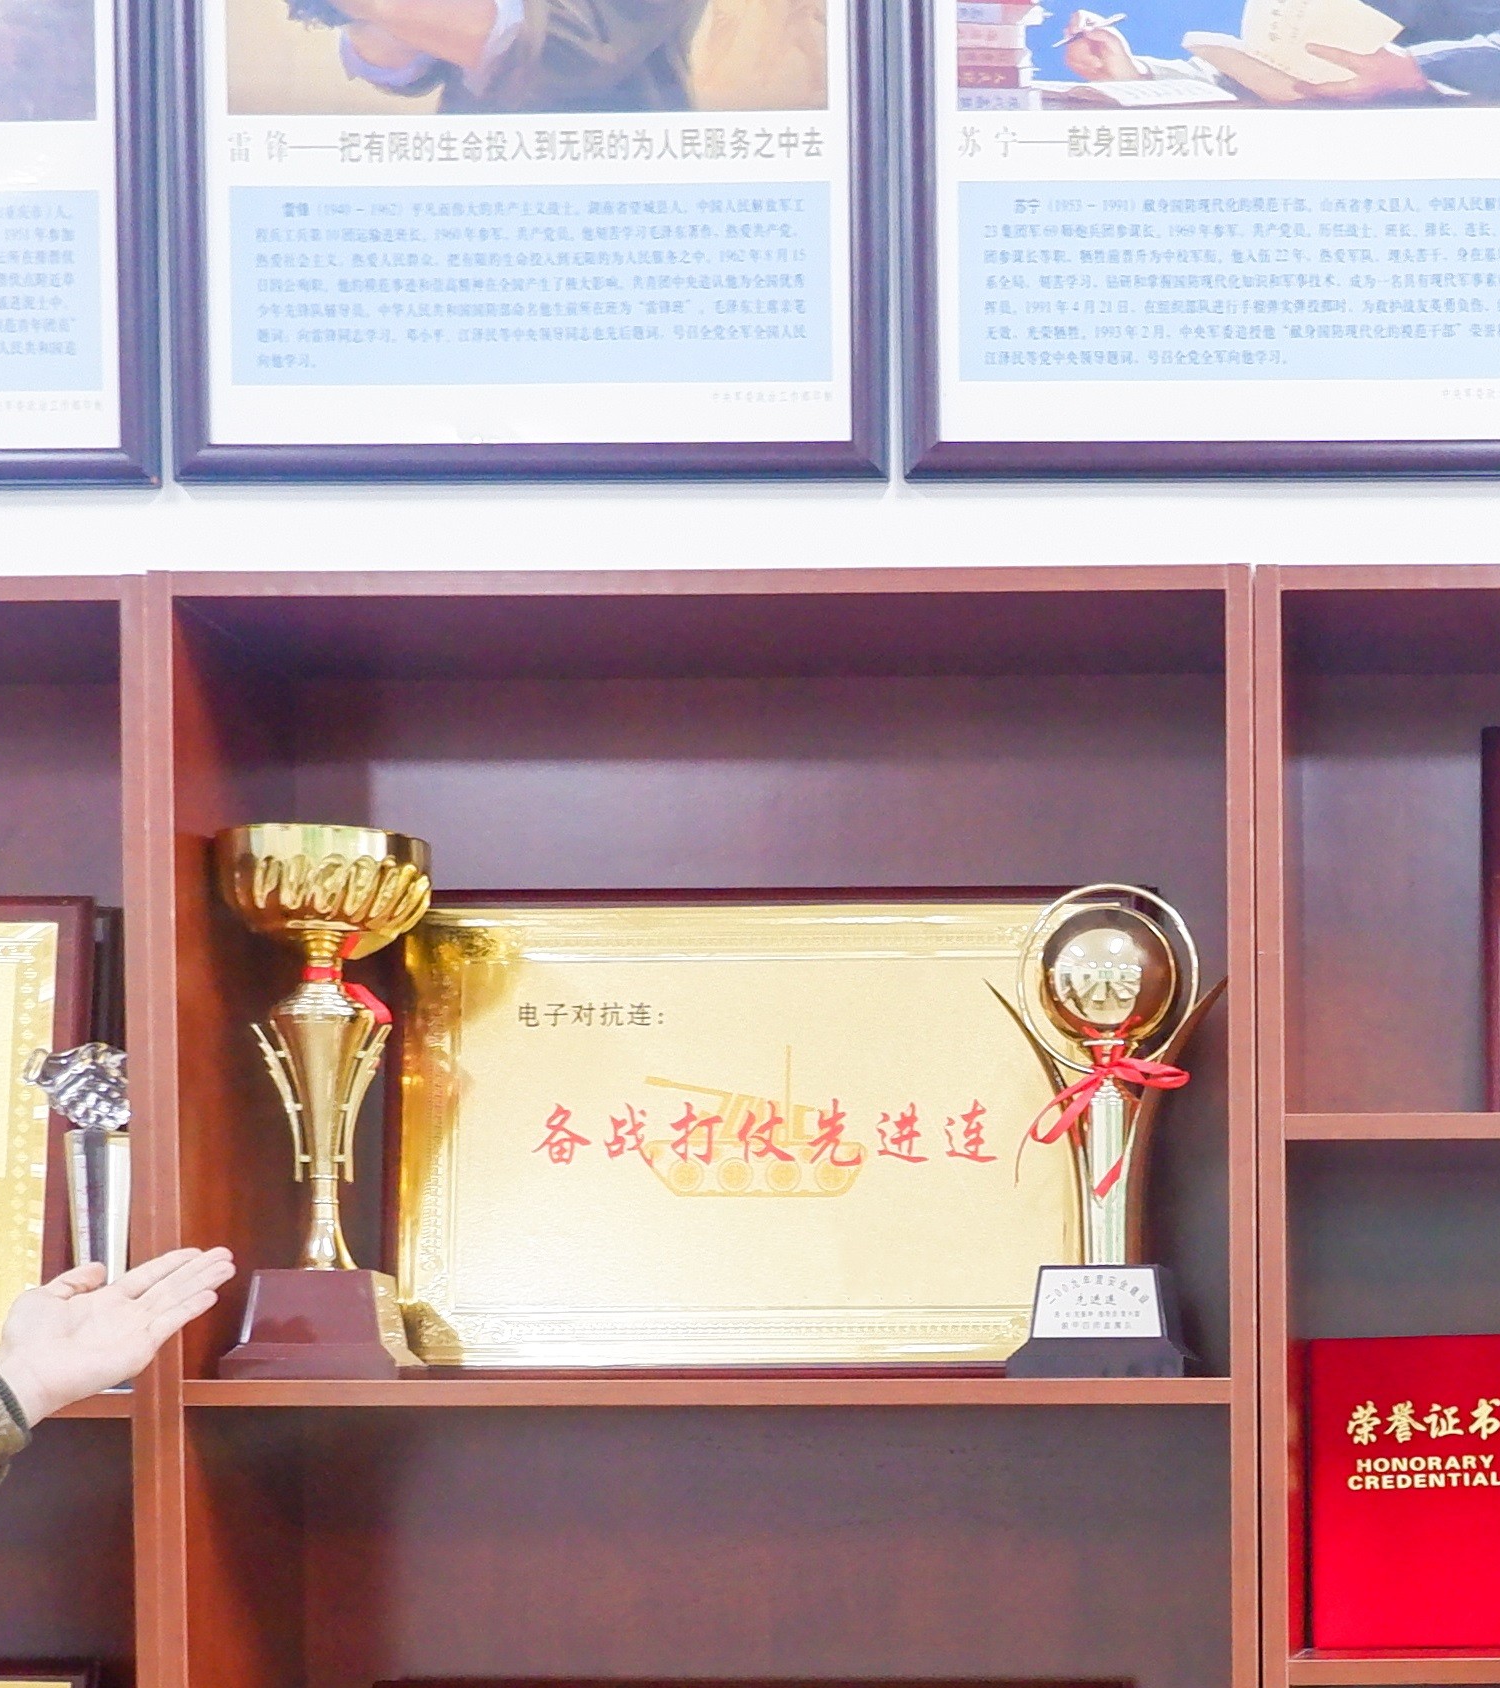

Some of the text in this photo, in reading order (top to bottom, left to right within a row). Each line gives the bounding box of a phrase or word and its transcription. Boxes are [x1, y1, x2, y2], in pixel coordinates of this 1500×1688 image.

[532, 1099, 999, 1168] 备战打仗先进连
[1355, 1454, 1496, 1474] HONORARY
